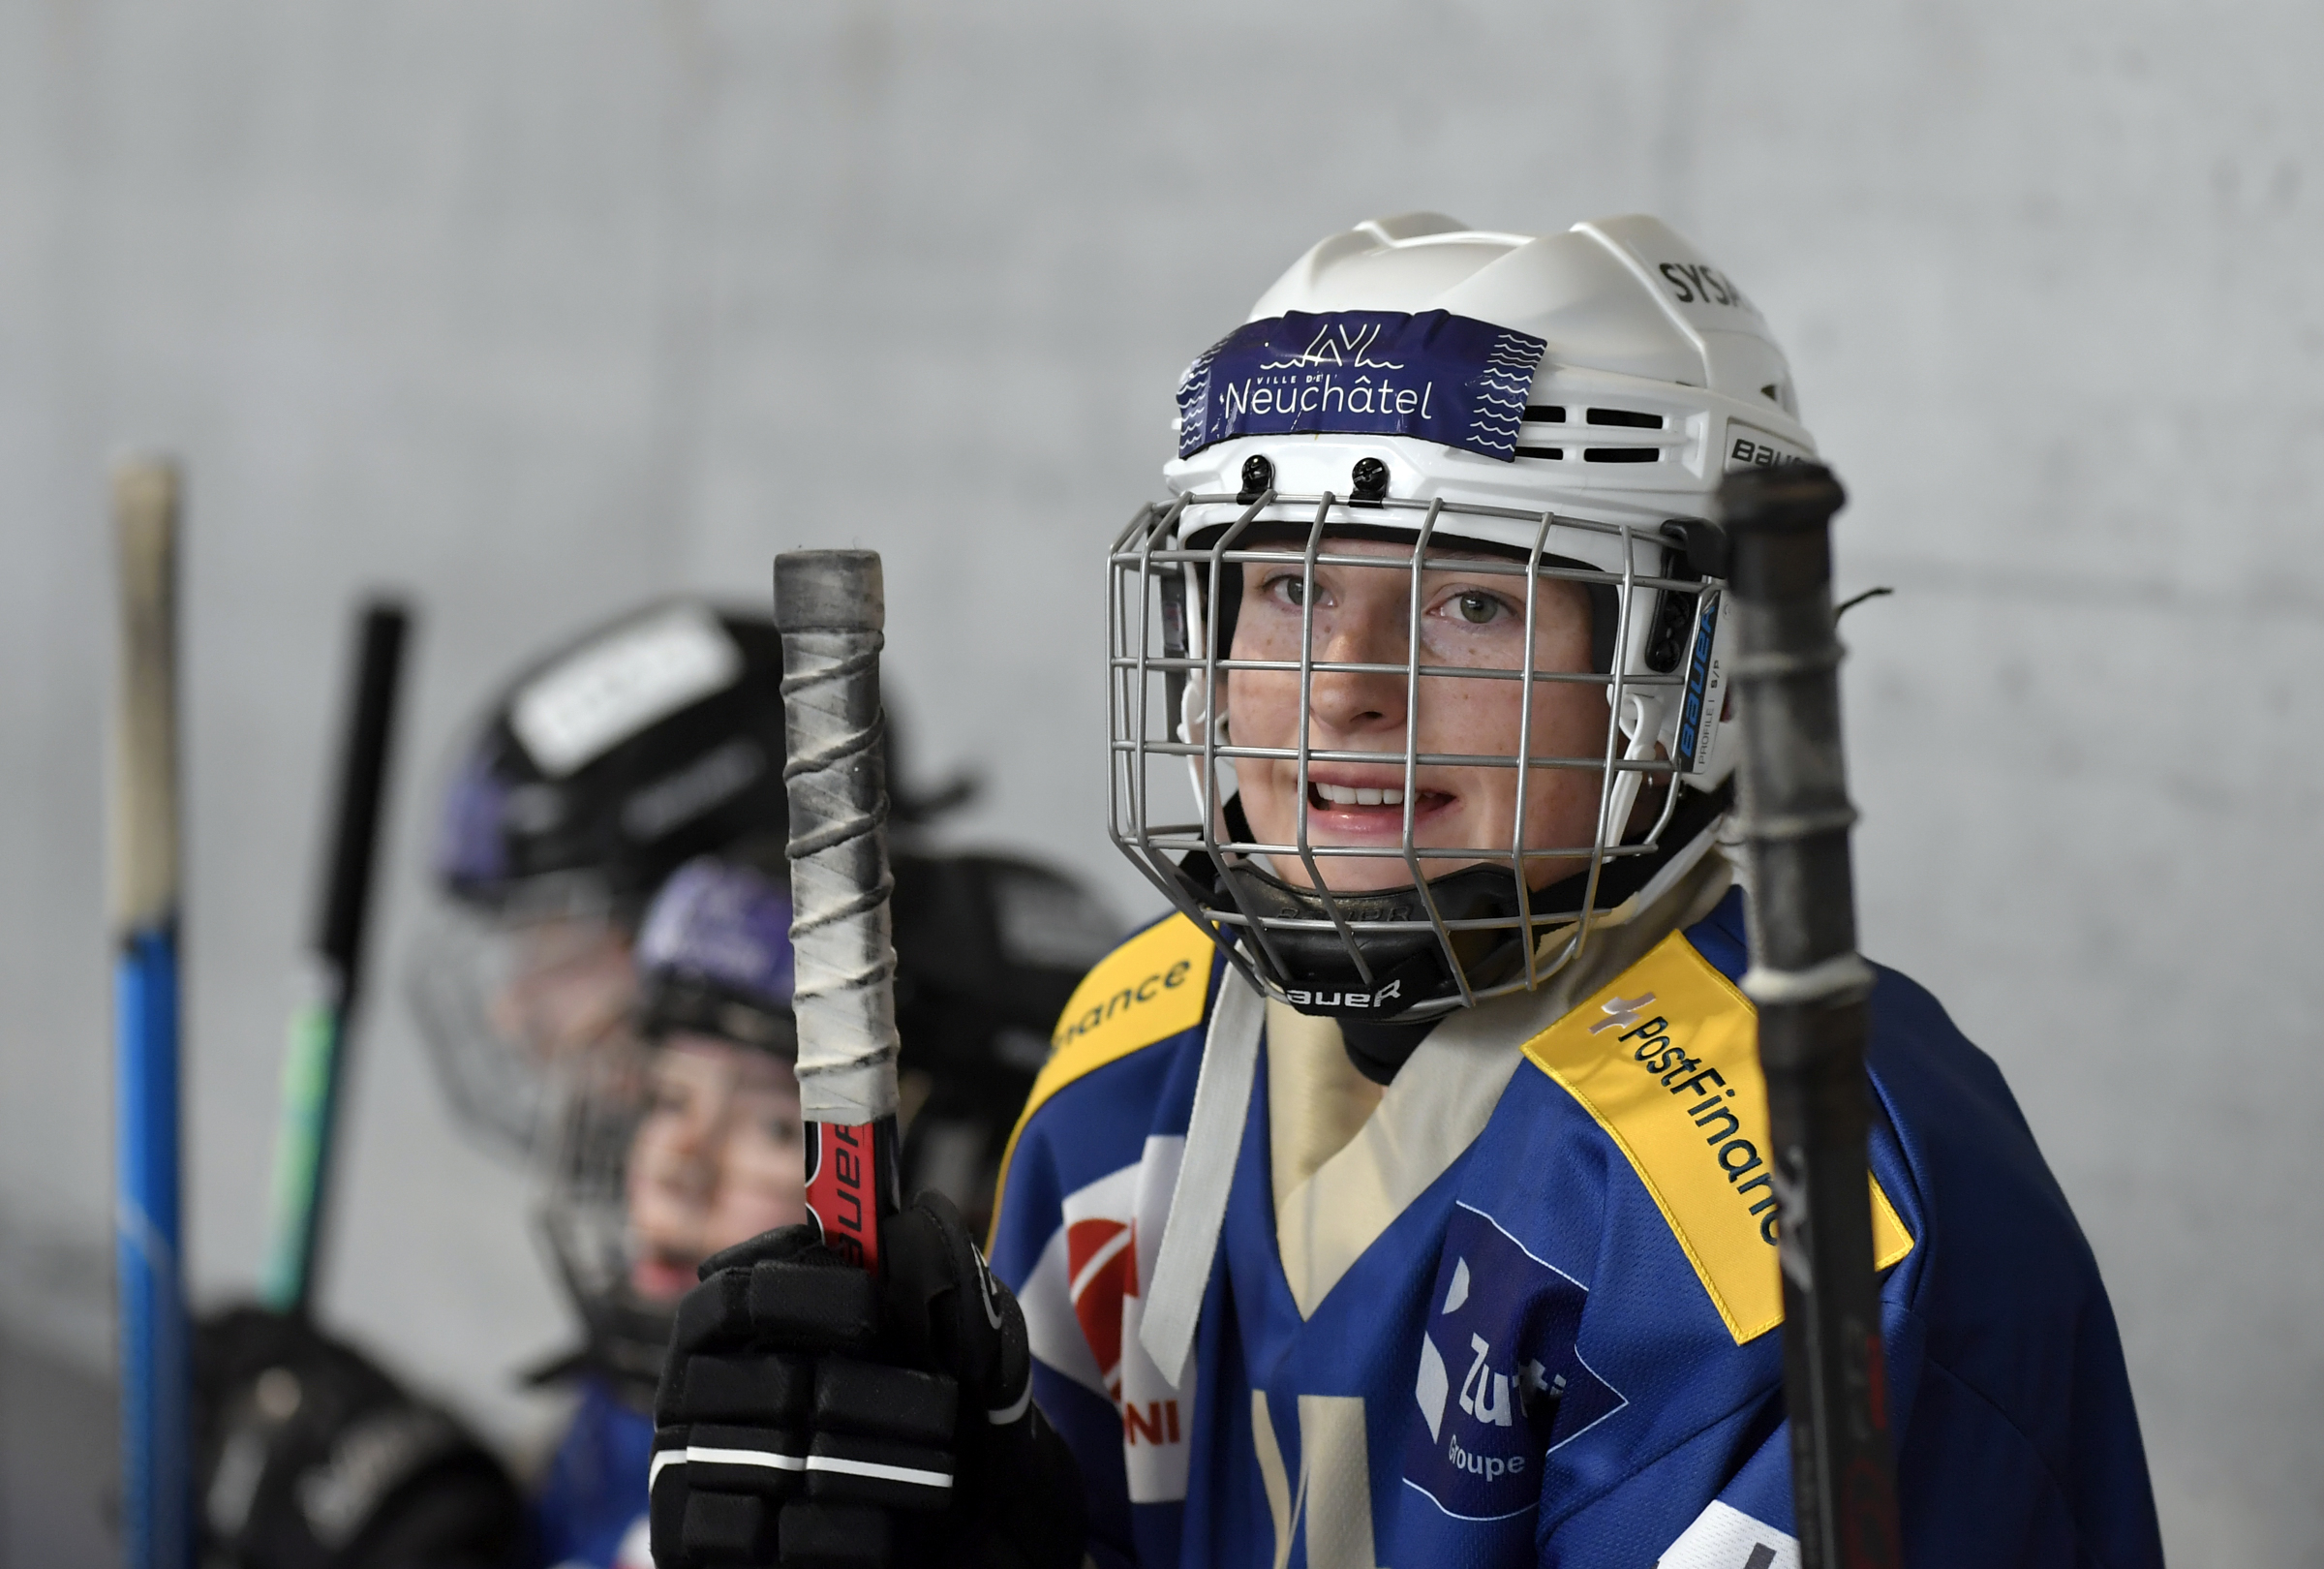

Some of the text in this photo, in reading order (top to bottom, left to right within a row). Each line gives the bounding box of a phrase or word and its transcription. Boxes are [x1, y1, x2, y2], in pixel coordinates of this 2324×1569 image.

[1224, 374, 1433, 419] Neuchâtel
[1257, 376, 1297, 385] VILLE
[1698, 707, 1716, 765] PROFILE
[1618, 1016, 1779, 1246] PostFinan
[1449, 1433, 1525, 1482] Groupe
